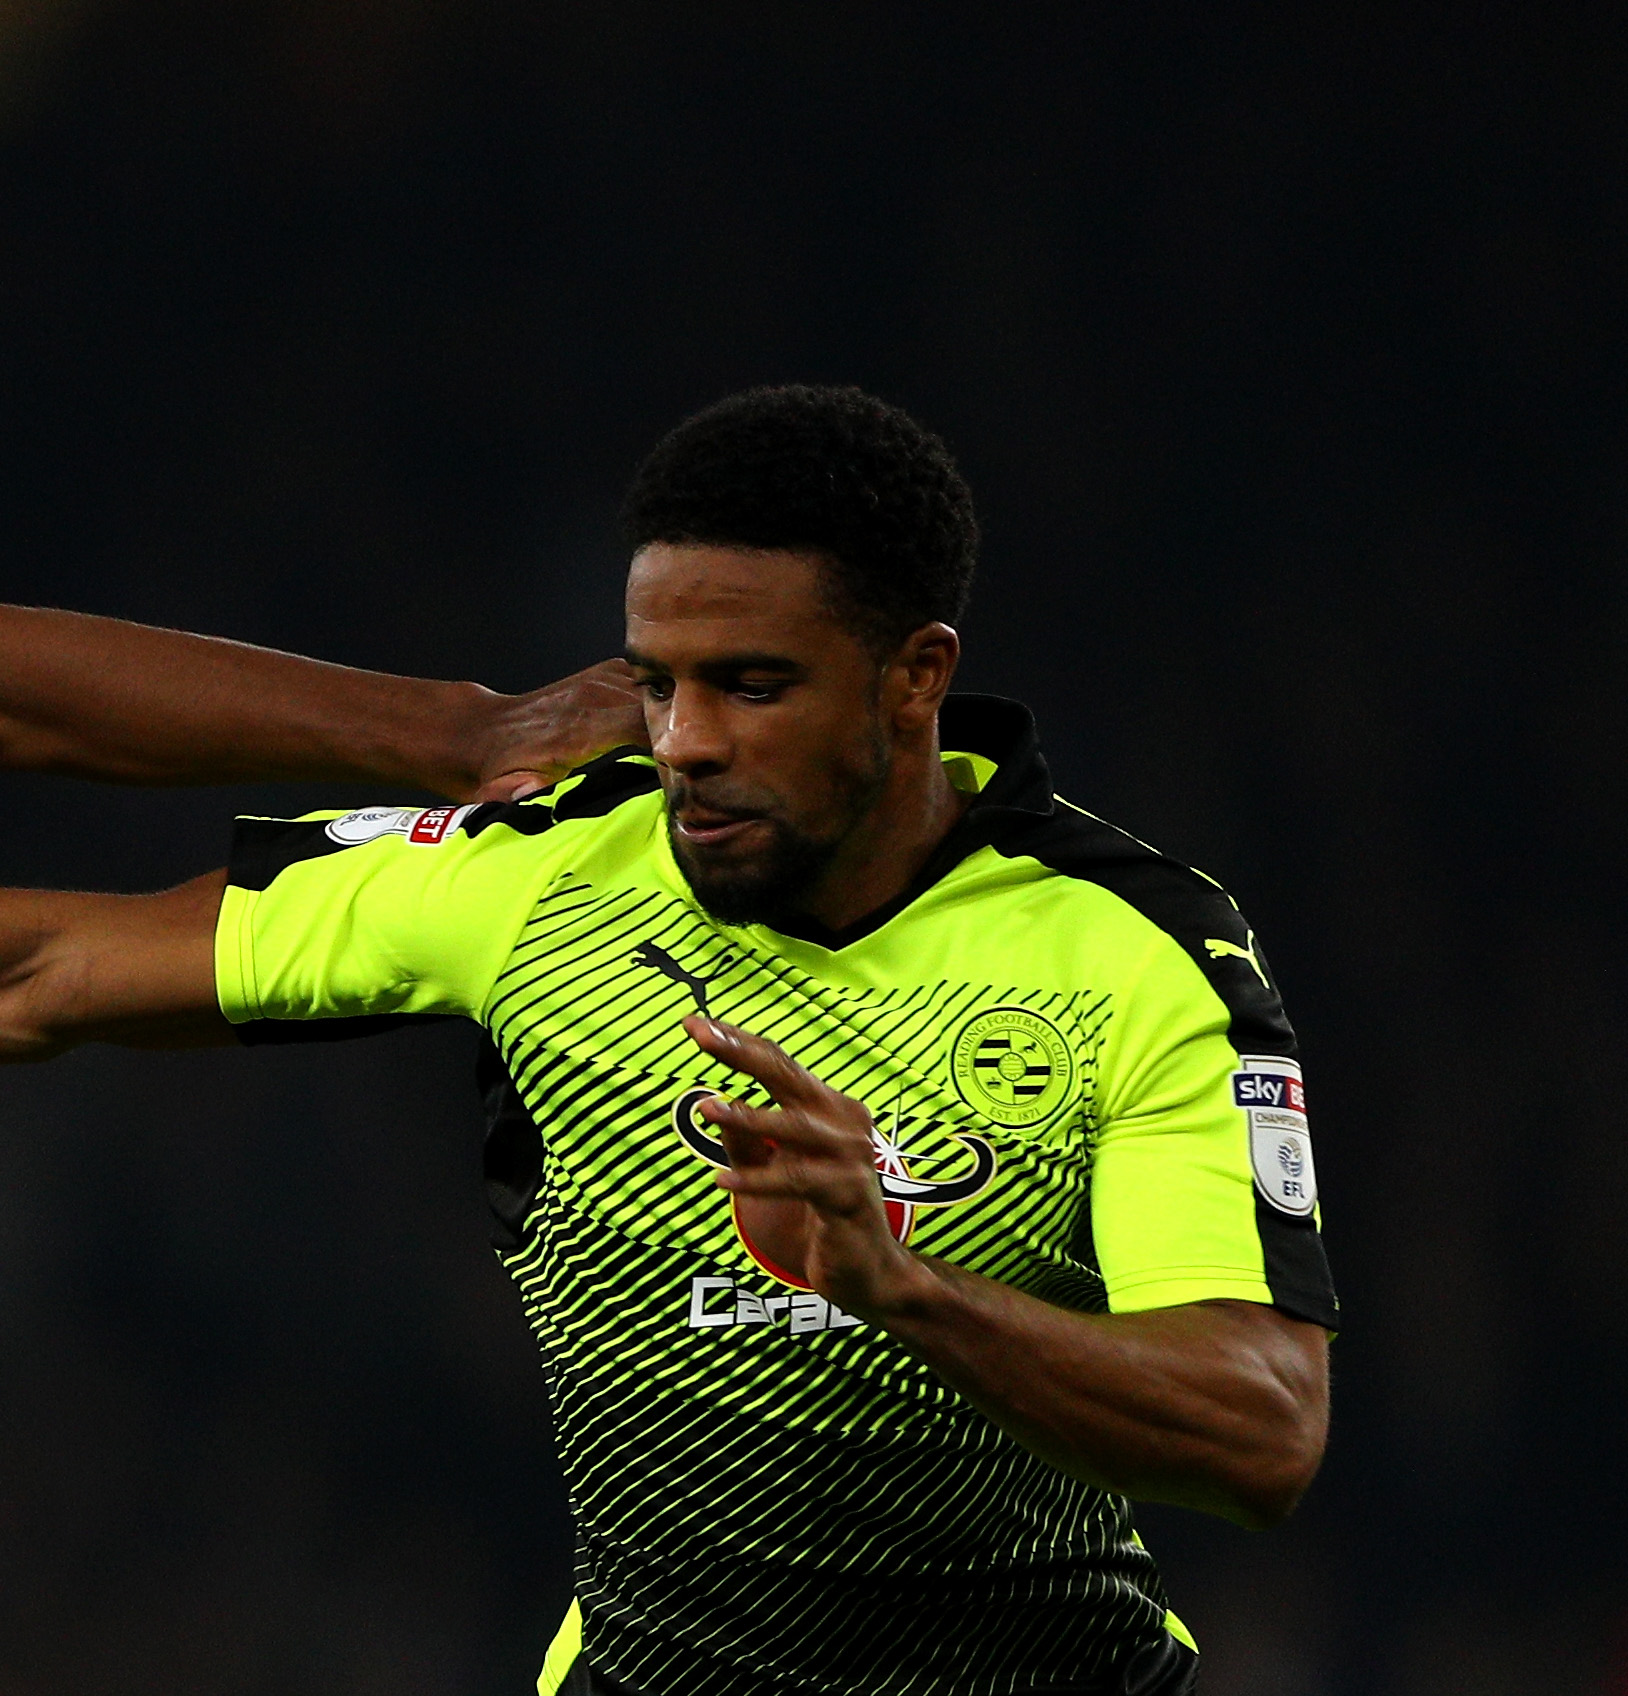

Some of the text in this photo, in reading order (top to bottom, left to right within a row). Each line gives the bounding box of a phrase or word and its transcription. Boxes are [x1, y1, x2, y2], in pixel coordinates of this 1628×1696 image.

[418, 809, 451, 839] BET
[957, 1013, 1068, 1078] READING FOOTBALL CLUB
[1238, 1075, 1284, 1106] sky
[688, 1276, 865, 1334] Cara
